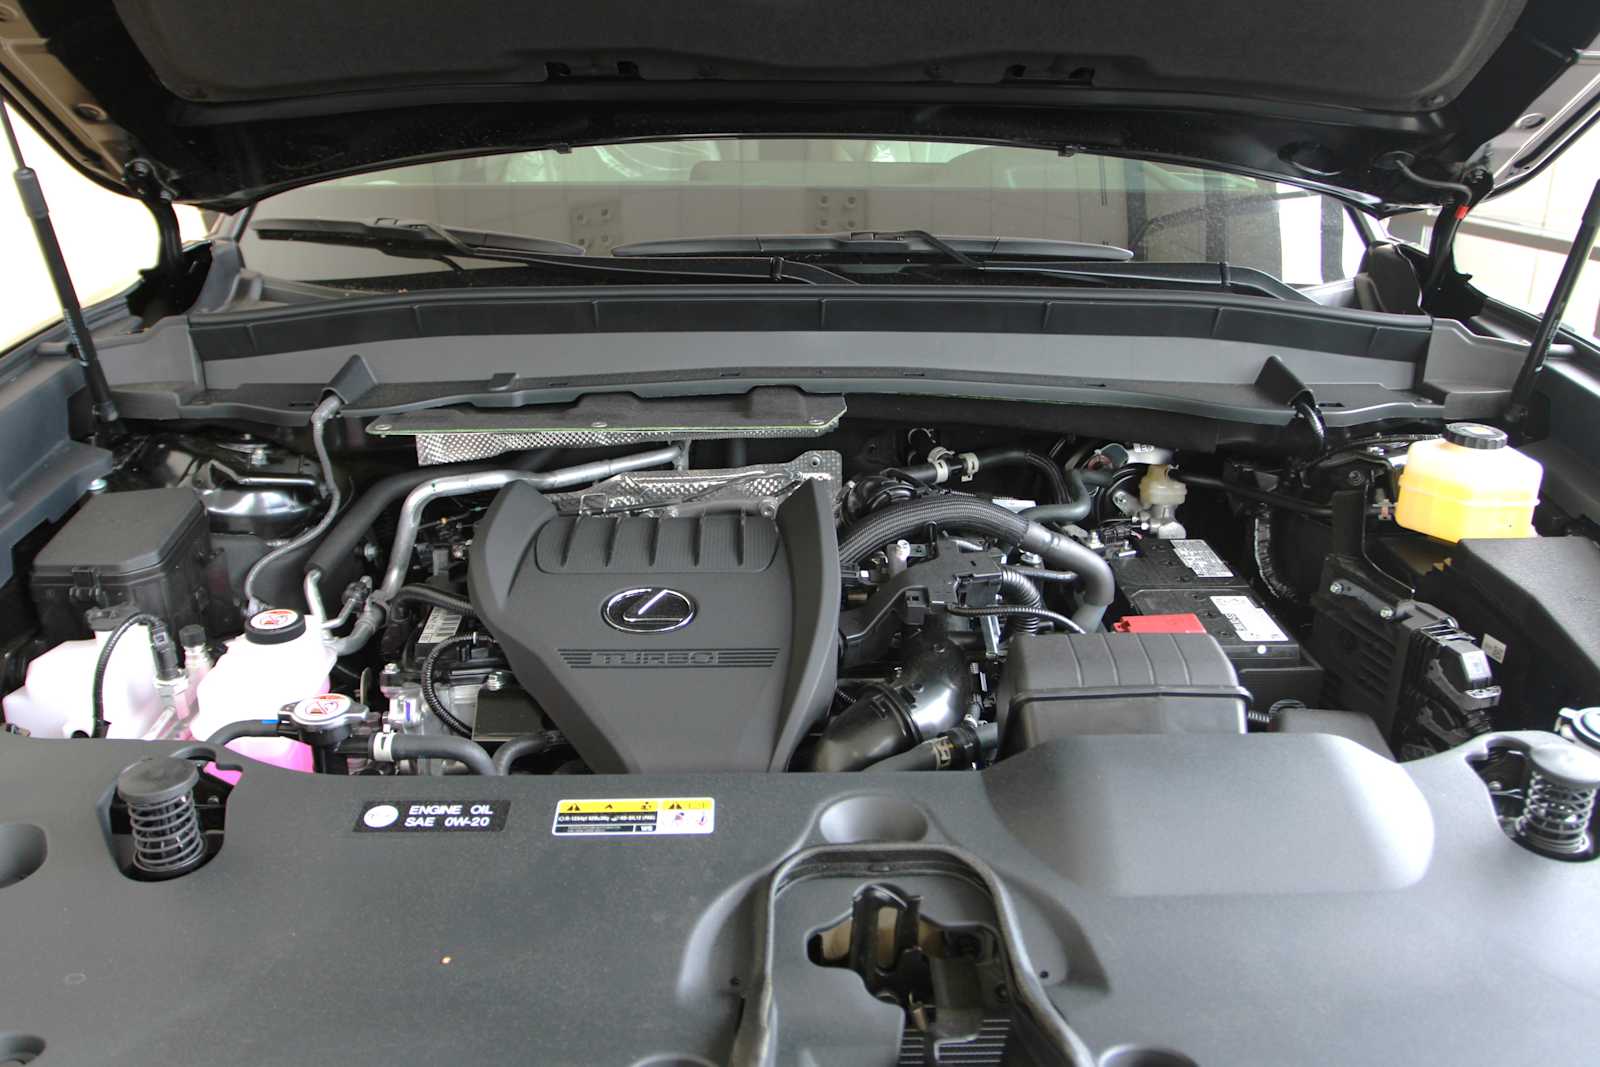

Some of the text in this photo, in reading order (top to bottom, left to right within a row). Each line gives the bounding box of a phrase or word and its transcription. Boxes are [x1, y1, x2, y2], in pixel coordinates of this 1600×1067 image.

[409, 805, 493, 815] ENGINE OIL
[404, 817, 490, 827] SAE 0W-20
